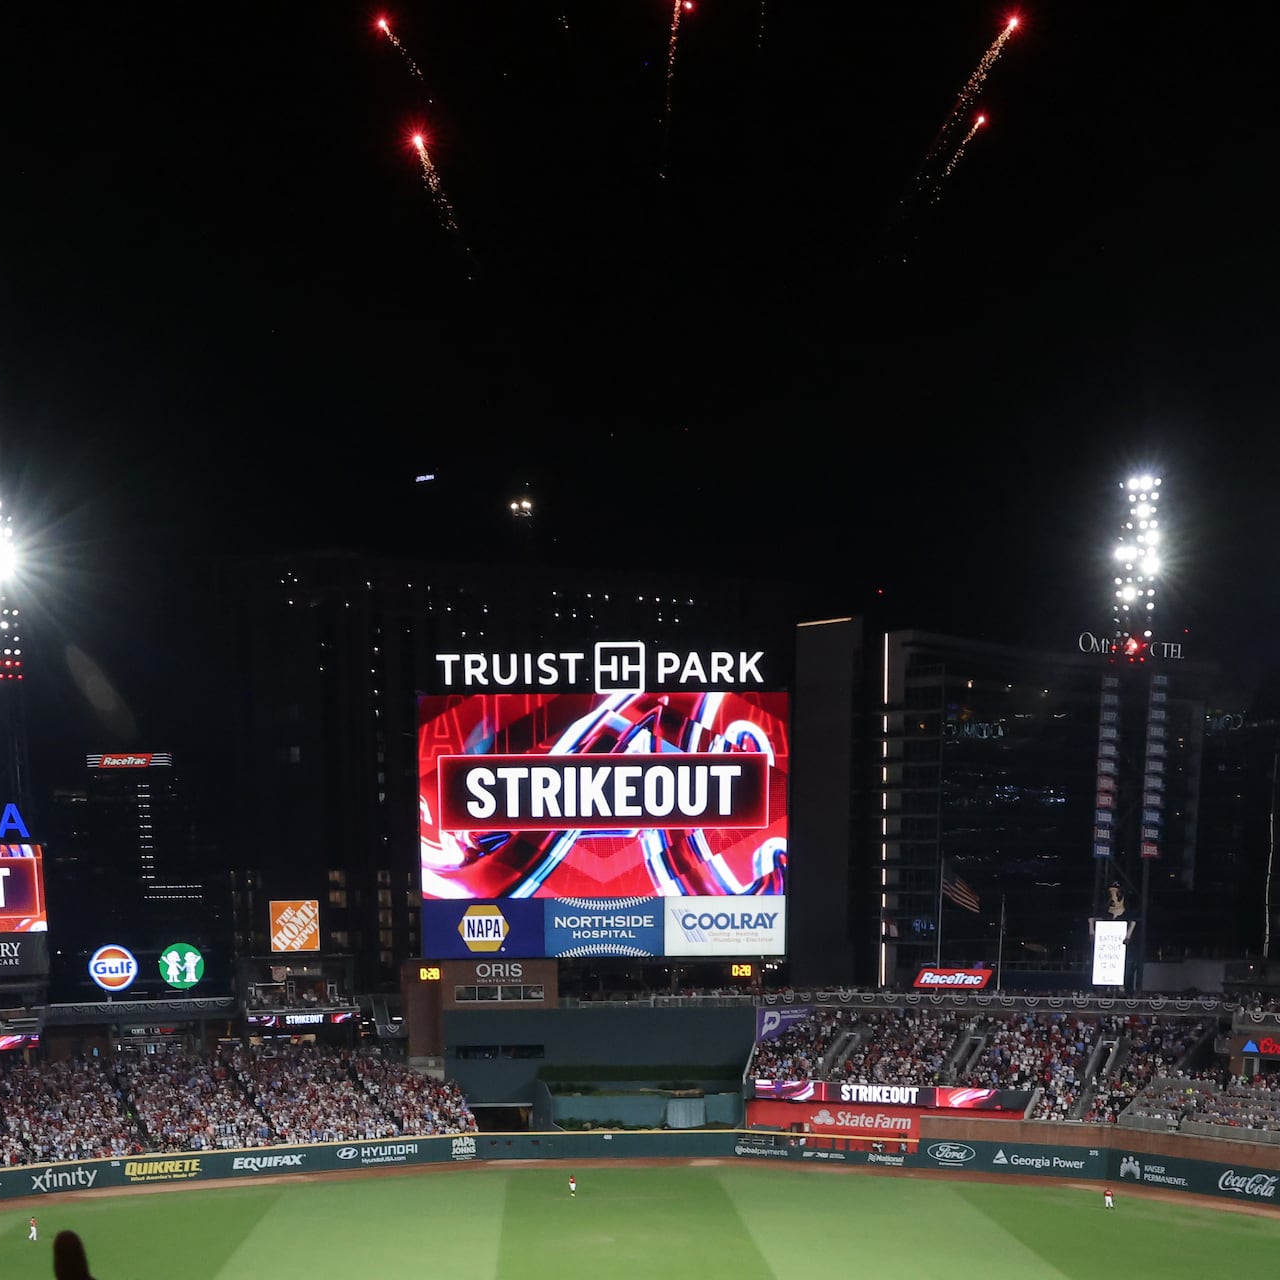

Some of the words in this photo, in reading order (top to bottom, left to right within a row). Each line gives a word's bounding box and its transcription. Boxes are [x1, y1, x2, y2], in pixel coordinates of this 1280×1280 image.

[435, 653, 584, 686] TRUIST
[657, 652, 765, 684] PARK
[103, 757, 147, 766] RaceTrac
[466, 765, 741, 819] STRIKEOUT
[276, 906, 296, 926] THE
[553, 915, 654, 928] NORTHSIDE
[681, 913, 779, 930] COOLRAY
[272, 901, 318, 951] HOME
[467, 918, 503, 939] NAPA
[291, 921, 318, 950] DEPOT
[572, 930, 636, 939] HOSPITAL
[93, 961, 132, 974] Gulf
[476, 963, 522, 977] ORIS
[920, 972, 982, 984] RaceTrac
[286, 1014, 323, 1024] STRIKEOUT
[840, 1084, 919, 1105] STRIKEOUT
[452, 1136, 476, 1148] PAPA
[361, 1143, 418, 1158] HYUNDAI
[452, 1145, 476, 1155] JOHNS
[936, 1145, 967, 1161] Ford
[232, 1154, 304, 1172] EQUIFAX
[876, 1154, 904, 1165] National
[1011, 1155, 1050, 1169] Georgia
[1052, 1156, 1085, 1169] Power
[124, 1159, 201, 1177] QUIKRETE
[1144, 1165, 1166, 1174] KAISER
[31, 1168, 97, 1193] xfinity
[1218, 1169, 1279, 1198] Coca-Cola
